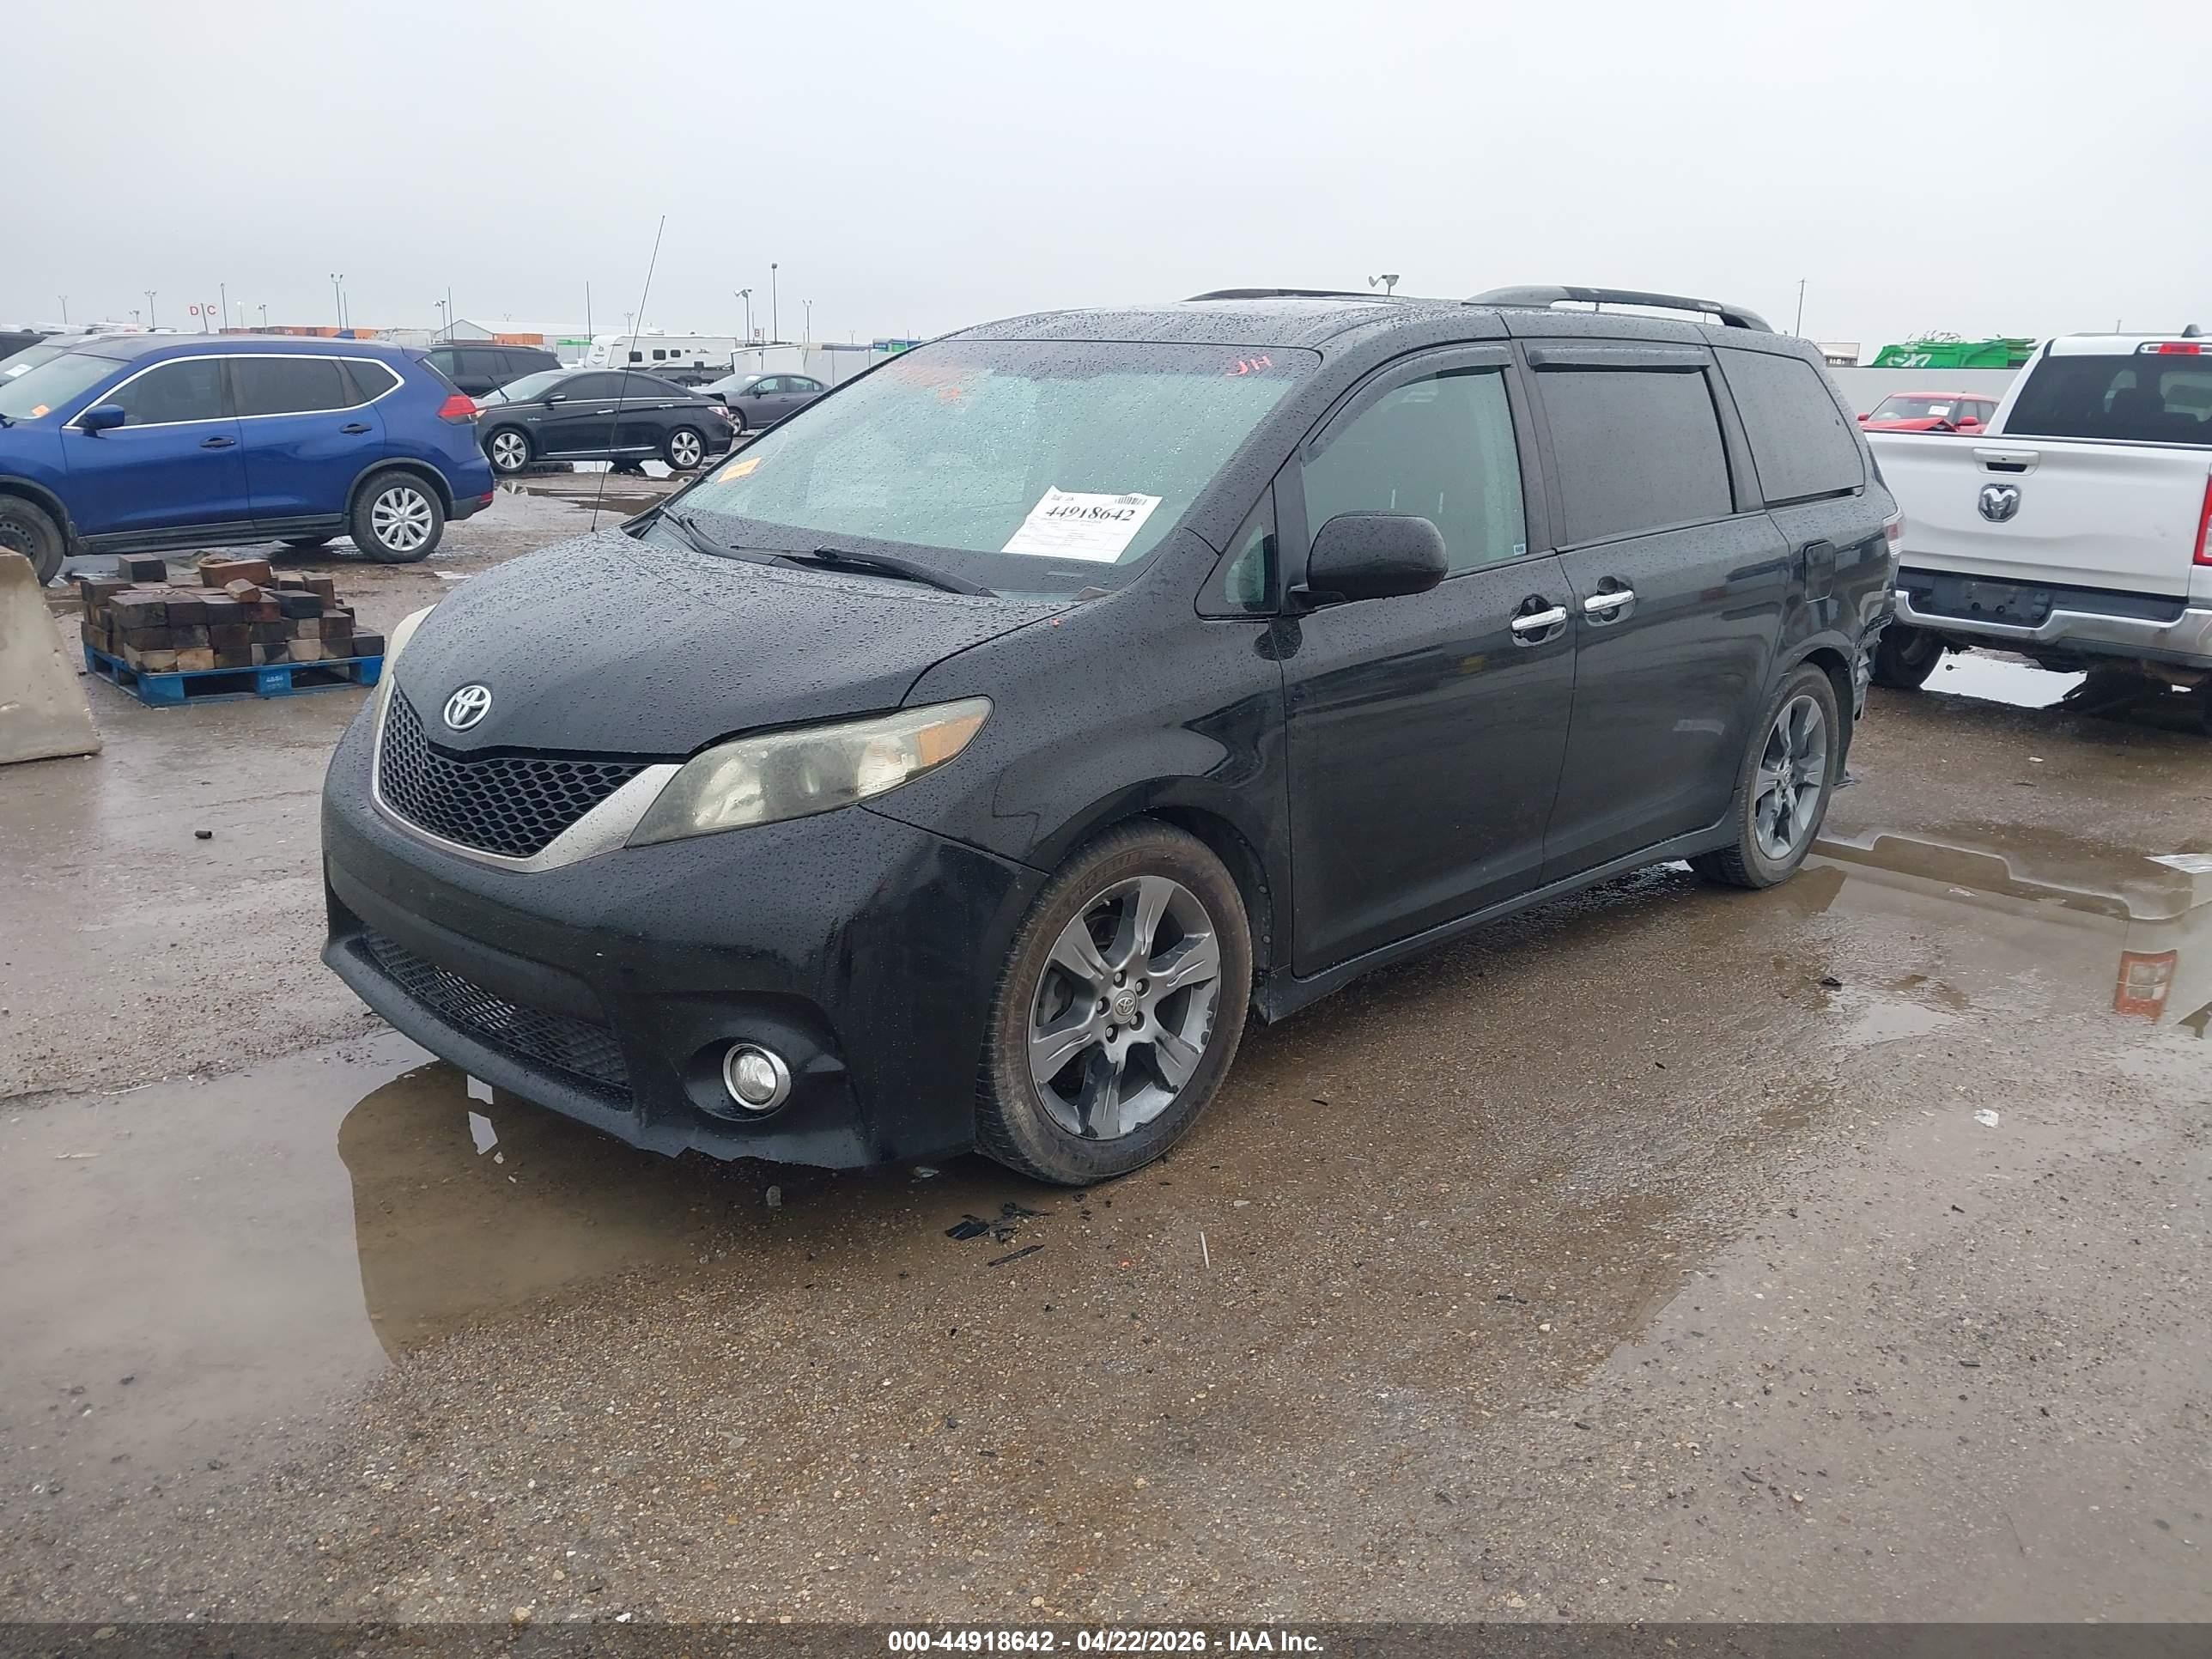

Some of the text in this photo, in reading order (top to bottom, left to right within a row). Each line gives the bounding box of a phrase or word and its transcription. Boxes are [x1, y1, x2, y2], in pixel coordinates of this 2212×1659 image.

[190, 306, 198, 315] D
[207, 305, 216, 315] C
[1046, 506, 1136, 521] 44918642
